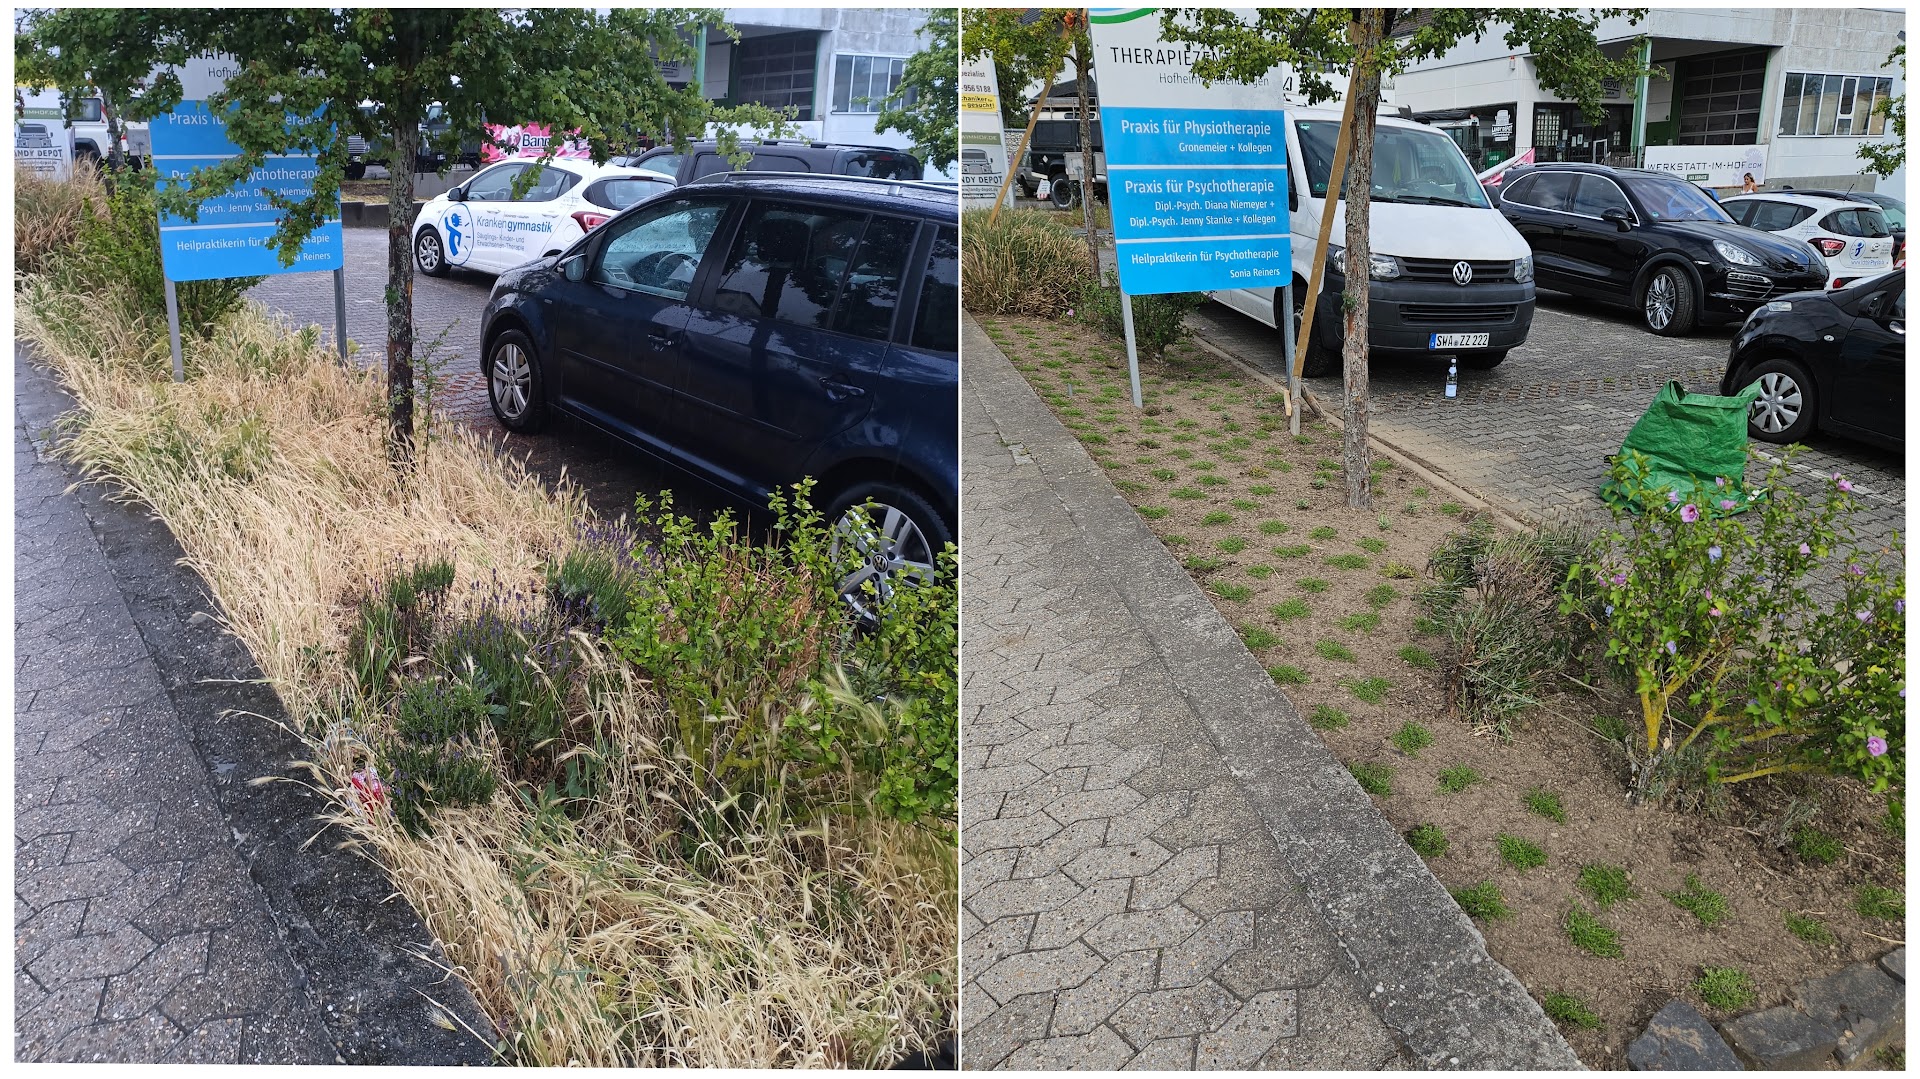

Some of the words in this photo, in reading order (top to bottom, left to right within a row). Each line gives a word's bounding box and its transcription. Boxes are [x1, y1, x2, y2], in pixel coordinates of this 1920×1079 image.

[168, 112, 208, 126] Praxis
[1121, 119, 1160, 134] Praxis
[1163, 119, 1181, 134] für
[1184, 120, 1271, 137] Physiotherapie
[37, 149, 62, 158] DEPOT
[1178, 142, 1228, 153] Gronemeier
[1237, 142, 1272, 154] Kollegen
[247, 167, 321, 184] ychotherapi
[978, 176, 1002, 184] DEPOT
[1125, 179, 1162, 194] Praxis
[1166, 180, 1183, 193] für
[1187, 178, 1275, 195] Psychotherapie
[228, 203, 252, 214] Jenny
[1155, 200, 1202, 212] Dipl.-Psych.
[1204, 200, 1228, 210] Diana
[1230, 199, 1268, 210] Niemeyer
[1129, 216, 1178, 229] Dipl.-Psych.
[1180, 216, 1204, 228] Jenny
[1206, 215, 1233, 225] Stanke
[1243, 214, 1276, 225] Kollegen
[176, 238, 246, 252] Heilpraktikerin
[248, 236, 261, 248] für
[303, 252, 331, 261] Reiners
[1131, 252, 1198, 265] Heilpraktikerin
[1200, 251, 1213, 262] für
[1215, 249, 1280, 262] Psychotherapie
[1230, 268, 1251, 279] Sonia
[1253, 267, 1281, 278] Reiners
[1460, 335, 1471, 346] ZZ
[1472, 335, 1488, 346] 222
